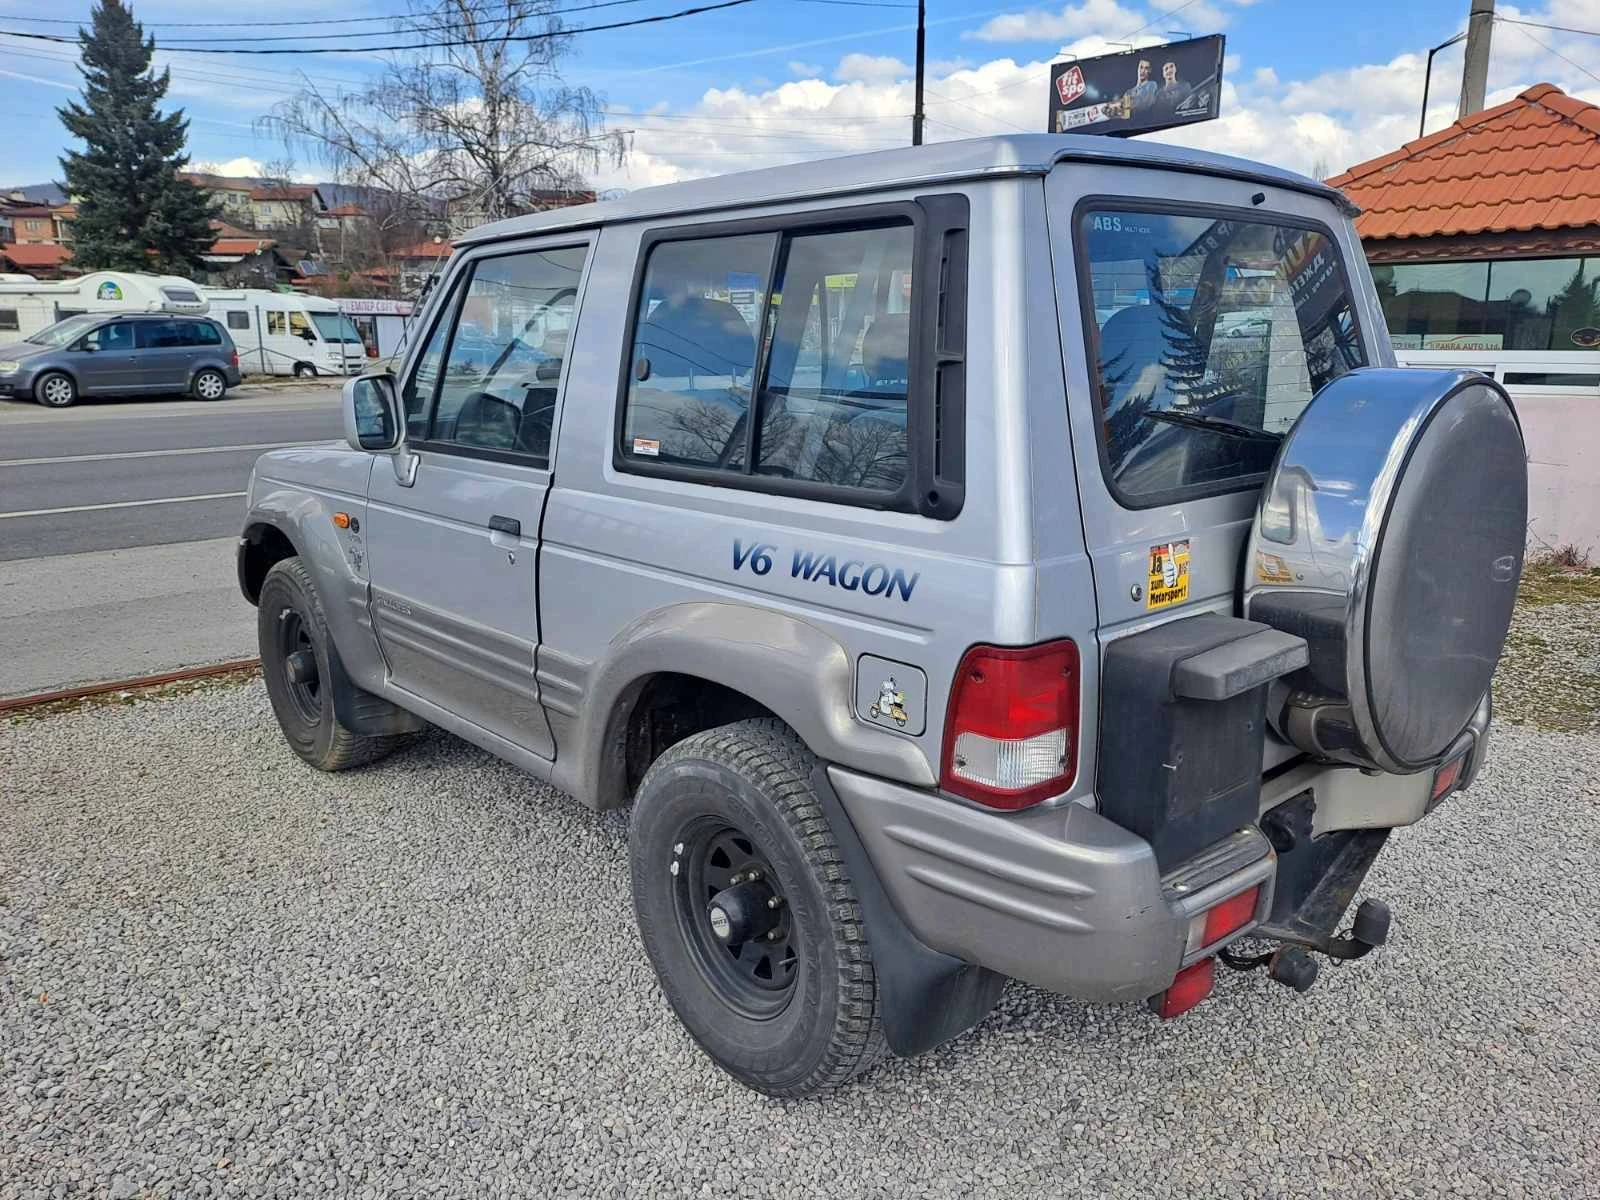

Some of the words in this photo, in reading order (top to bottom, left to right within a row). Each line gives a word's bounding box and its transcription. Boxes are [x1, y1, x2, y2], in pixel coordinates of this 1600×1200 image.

[1062, 71, 1079, 86] fit
[1094, 216, 1122, 232] ABS
[733, 538, 778, 576] V6
[791, 550, 920, 602] WAGON
